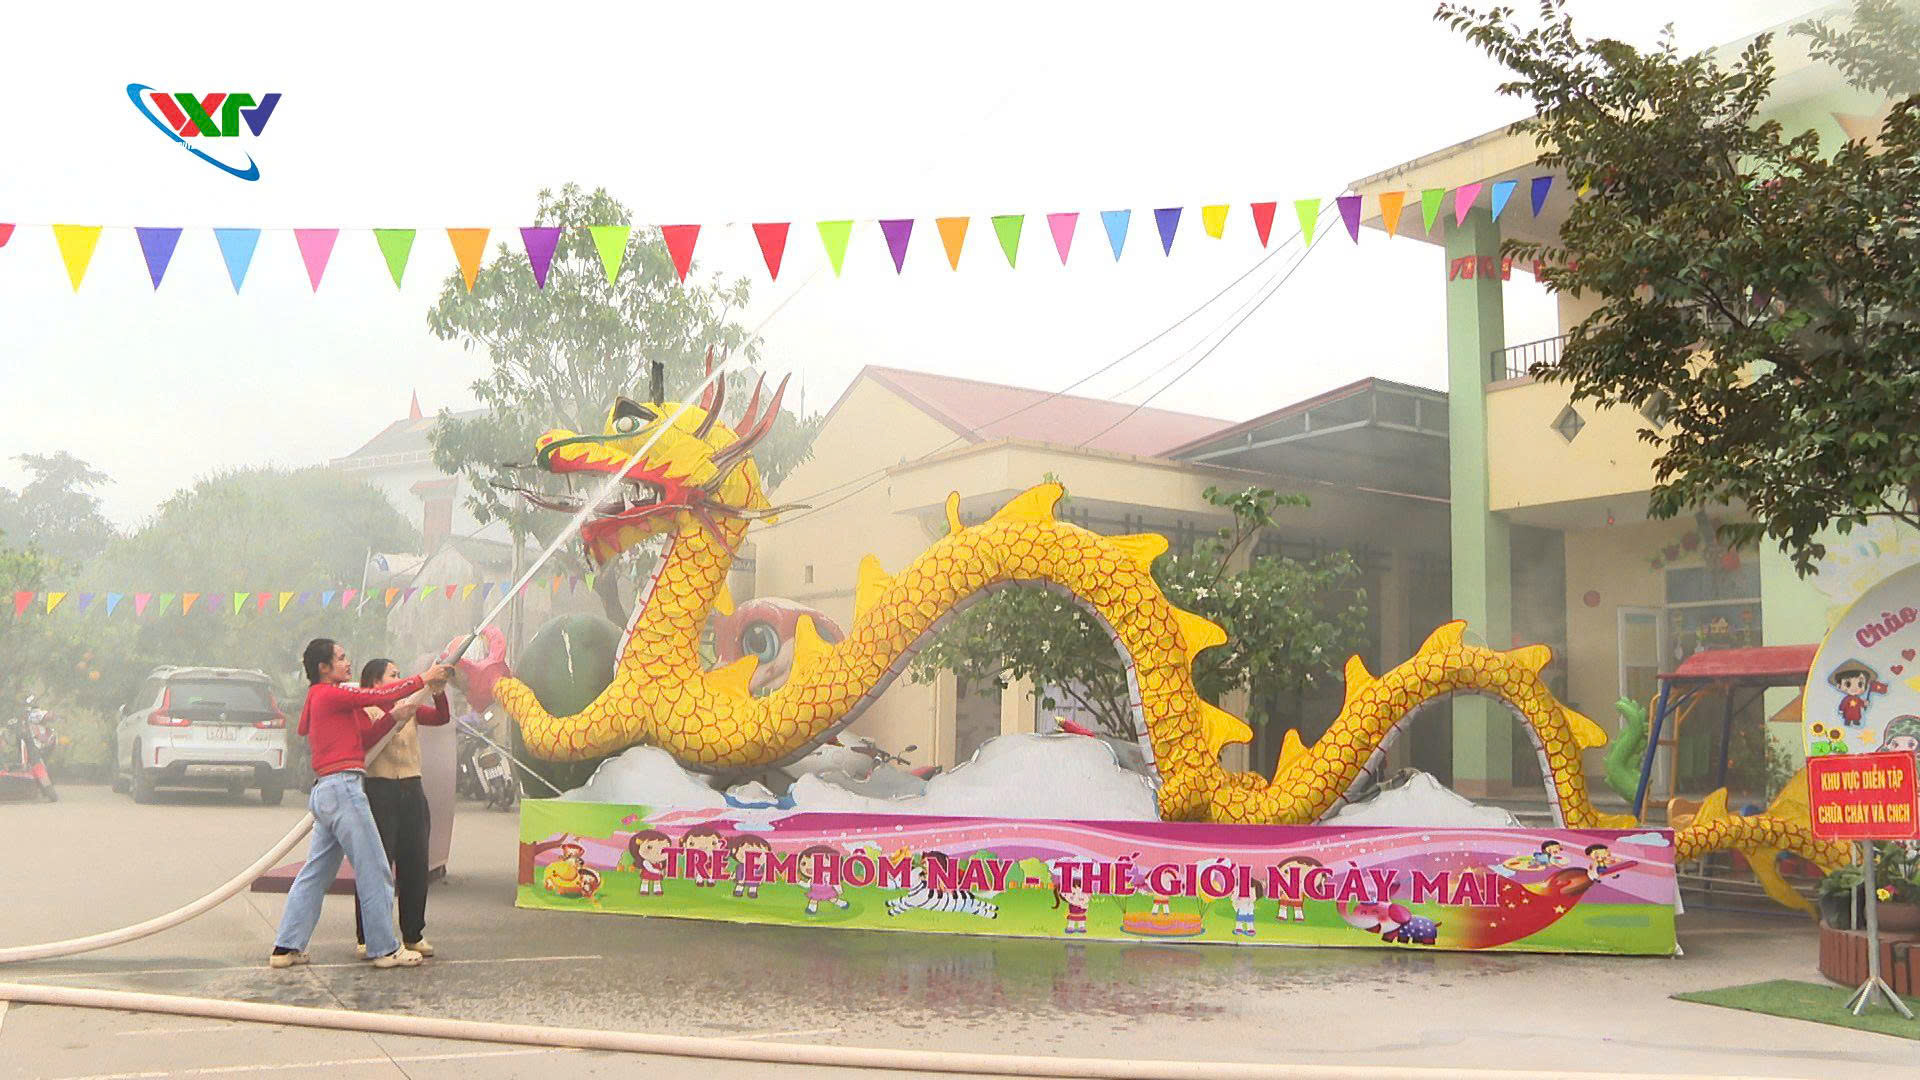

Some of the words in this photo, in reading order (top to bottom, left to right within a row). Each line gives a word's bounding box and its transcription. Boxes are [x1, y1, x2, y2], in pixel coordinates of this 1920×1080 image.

[1856, 606, 1918, 648] Chào
[1820, 771, 1841, 791] KHU
[1842, 769, 1860, 794] VỰC
[1887, 766, 1904, 792] TẬP
[1845, 800, 1869, 824] CHÁY
[1871, 801, 1886, 824] VÀ
[1887, 803, 1910, 824] CNCH
[661, 838, 732, 881] TRẺ
[744, 850, 799, 884] EM
[812, 847, 912, 889] HÔM
[927, 857, 1014, 892] NAY
[1053, 851, 1138, 896] THẾ
[1150, 857, 1252, 899] GIỚI
[1266, 860, 1400, 903] NGÀY
[1411, 869, 1500, 907] MAI
